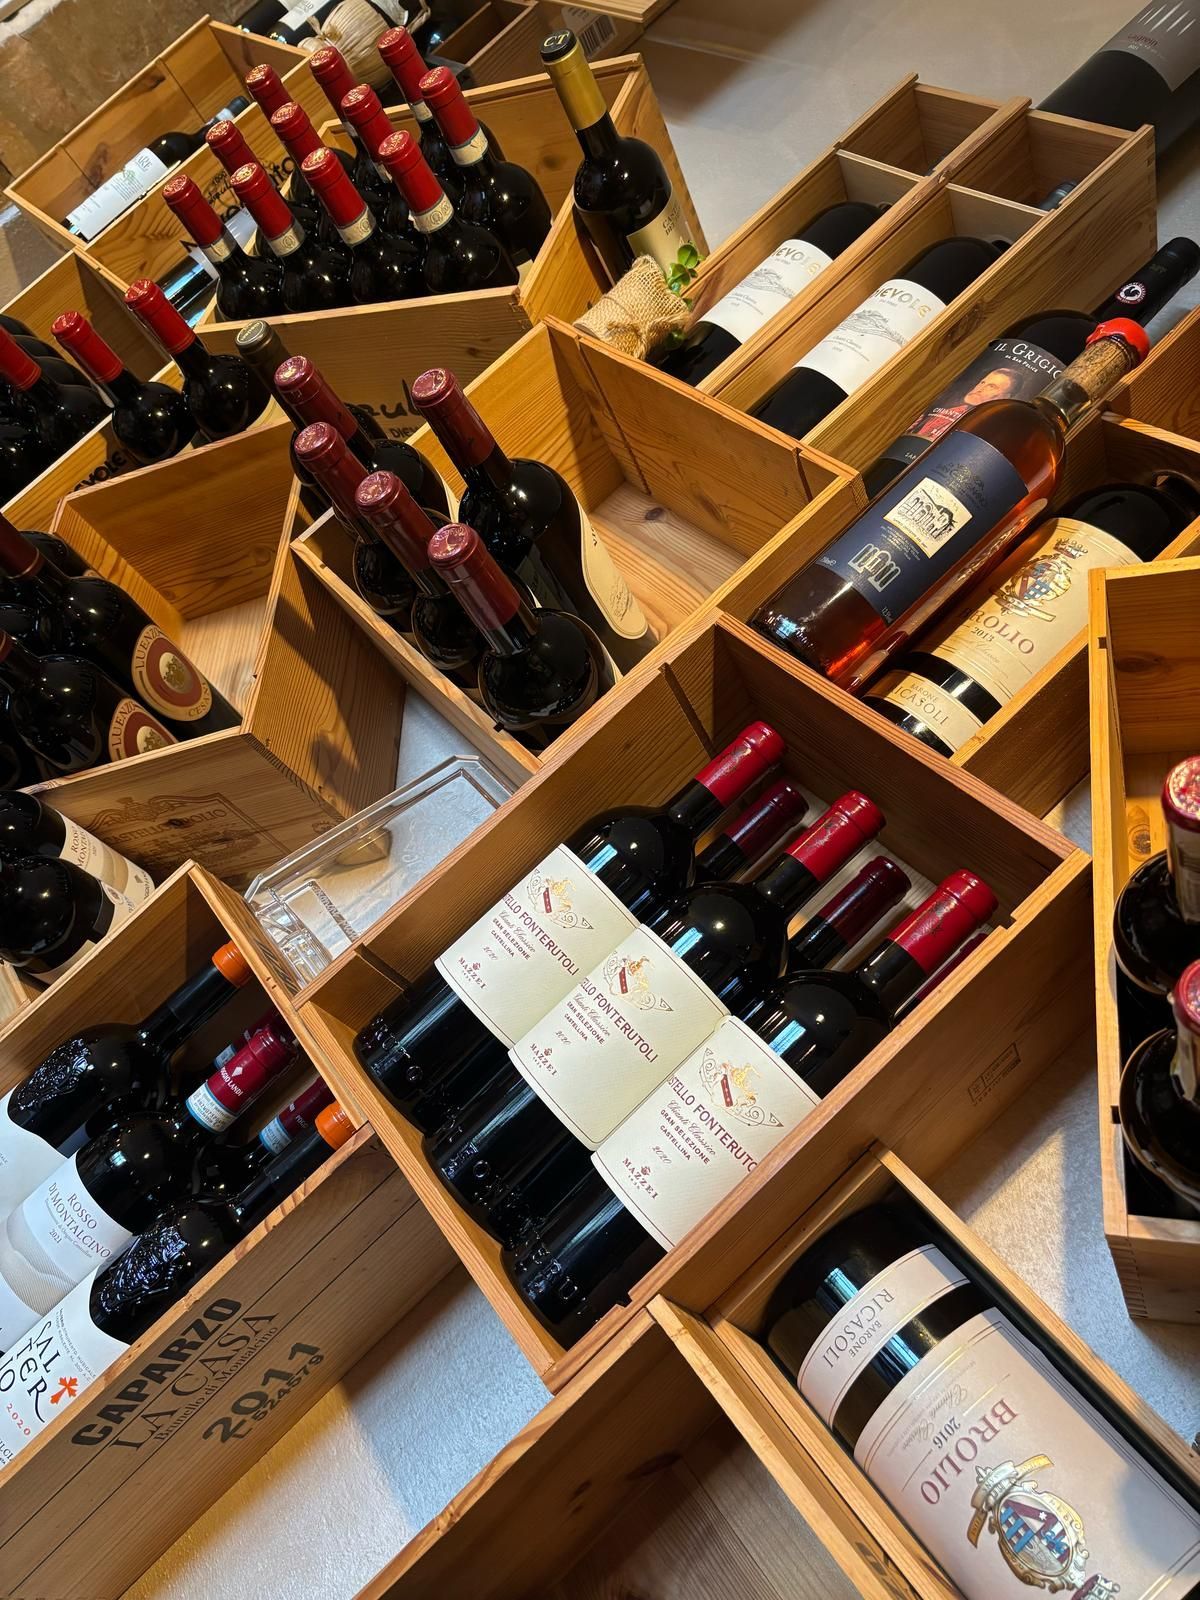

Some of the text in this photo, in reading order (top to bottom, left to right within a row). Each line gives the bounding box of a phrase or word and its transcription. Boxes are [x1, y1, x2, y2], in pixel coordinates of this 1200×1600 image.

[894, 686, 949, 725] ICASOLI
[490, 930, 515, 958] CASTELLINA
[502, 929, 531, 960] SELEZIONE
[519, 912, 579, 976] FONTERUTOLI
[458, 957, 487, 990] MAZZEI
[564, 1013, 588, 1042] CASTELLINA
[575, 1012, 605, 1046] SELEZIONE
[593, 993, 659, 1064] FONTERUTOLI
[530, 1043, 559, 1077] MAZZEI
[660, 1109, 711, 1165] GRAN SELEZIONE
[660, 1125, 691, 1161] CASTELLINA
[693, 1104, 758, 1173] FONTERUTO
[622, 1158, 660, 1200] MAZZEI
[51, 1192, 112, 1259] MONTALCINO
[67, 1192, 98, 1230] ROSSO
[822, 1288, 895, 1369] RICASOLI
[848, 1320, 882, 1358] BARONE
[71, 1298, 242, 1446] CAPARZO
[215, 1327, 278, 1384] Montalcino
[110, 1312, 280, 1450] LA CASA
[202, 1343, 321, 1444] 2011
[6, 1403, 31, 1436] 2020
[933, 1416, 962, 1449] 2016
[920, 1398, 1020, 1505] BROLIO
